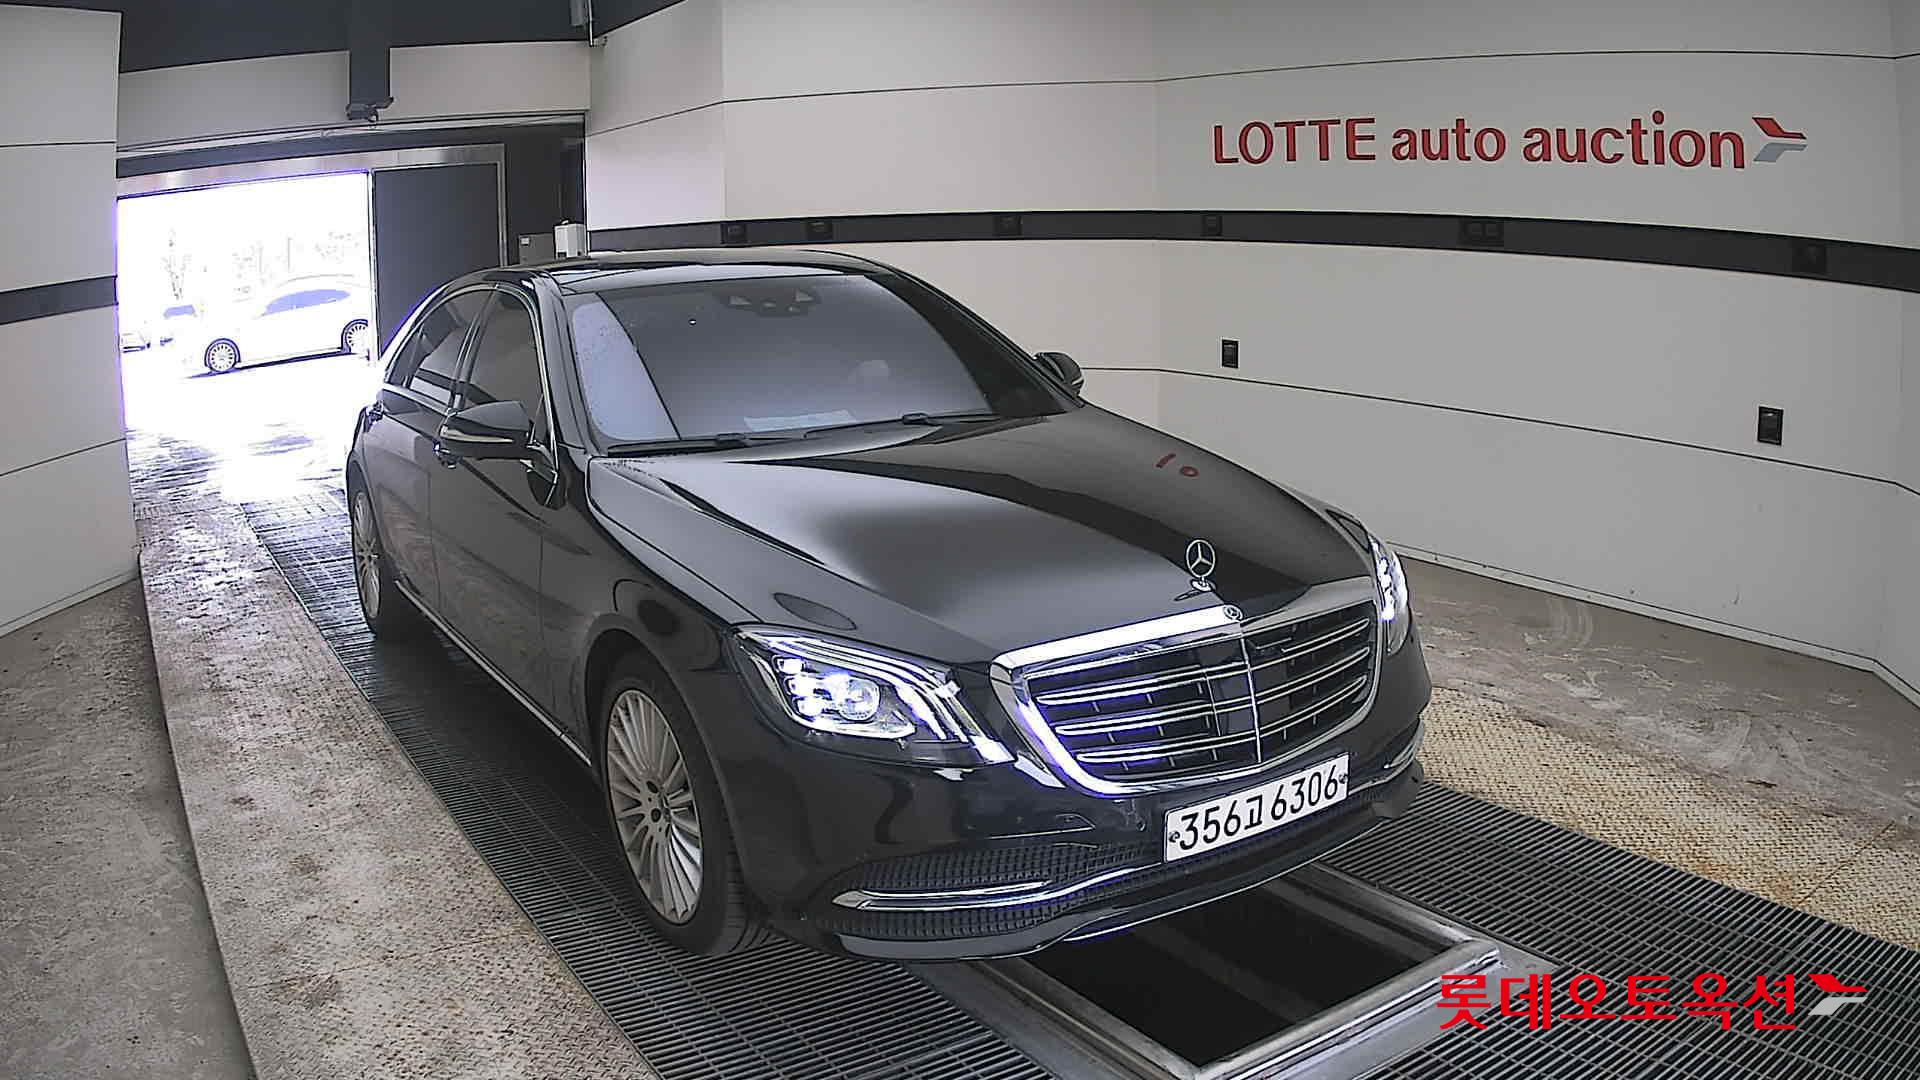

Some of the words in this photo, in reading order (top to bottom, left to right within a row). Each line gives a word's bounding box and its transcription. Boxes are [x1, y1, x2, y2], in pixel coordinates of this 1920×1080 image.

[1213, 117, 1376, 164] LOTTE
[1391, 118, 1507, 162] auto
[1522, 110, 1746, 169] auction
[1271, 764, 1338, 821] 6306
